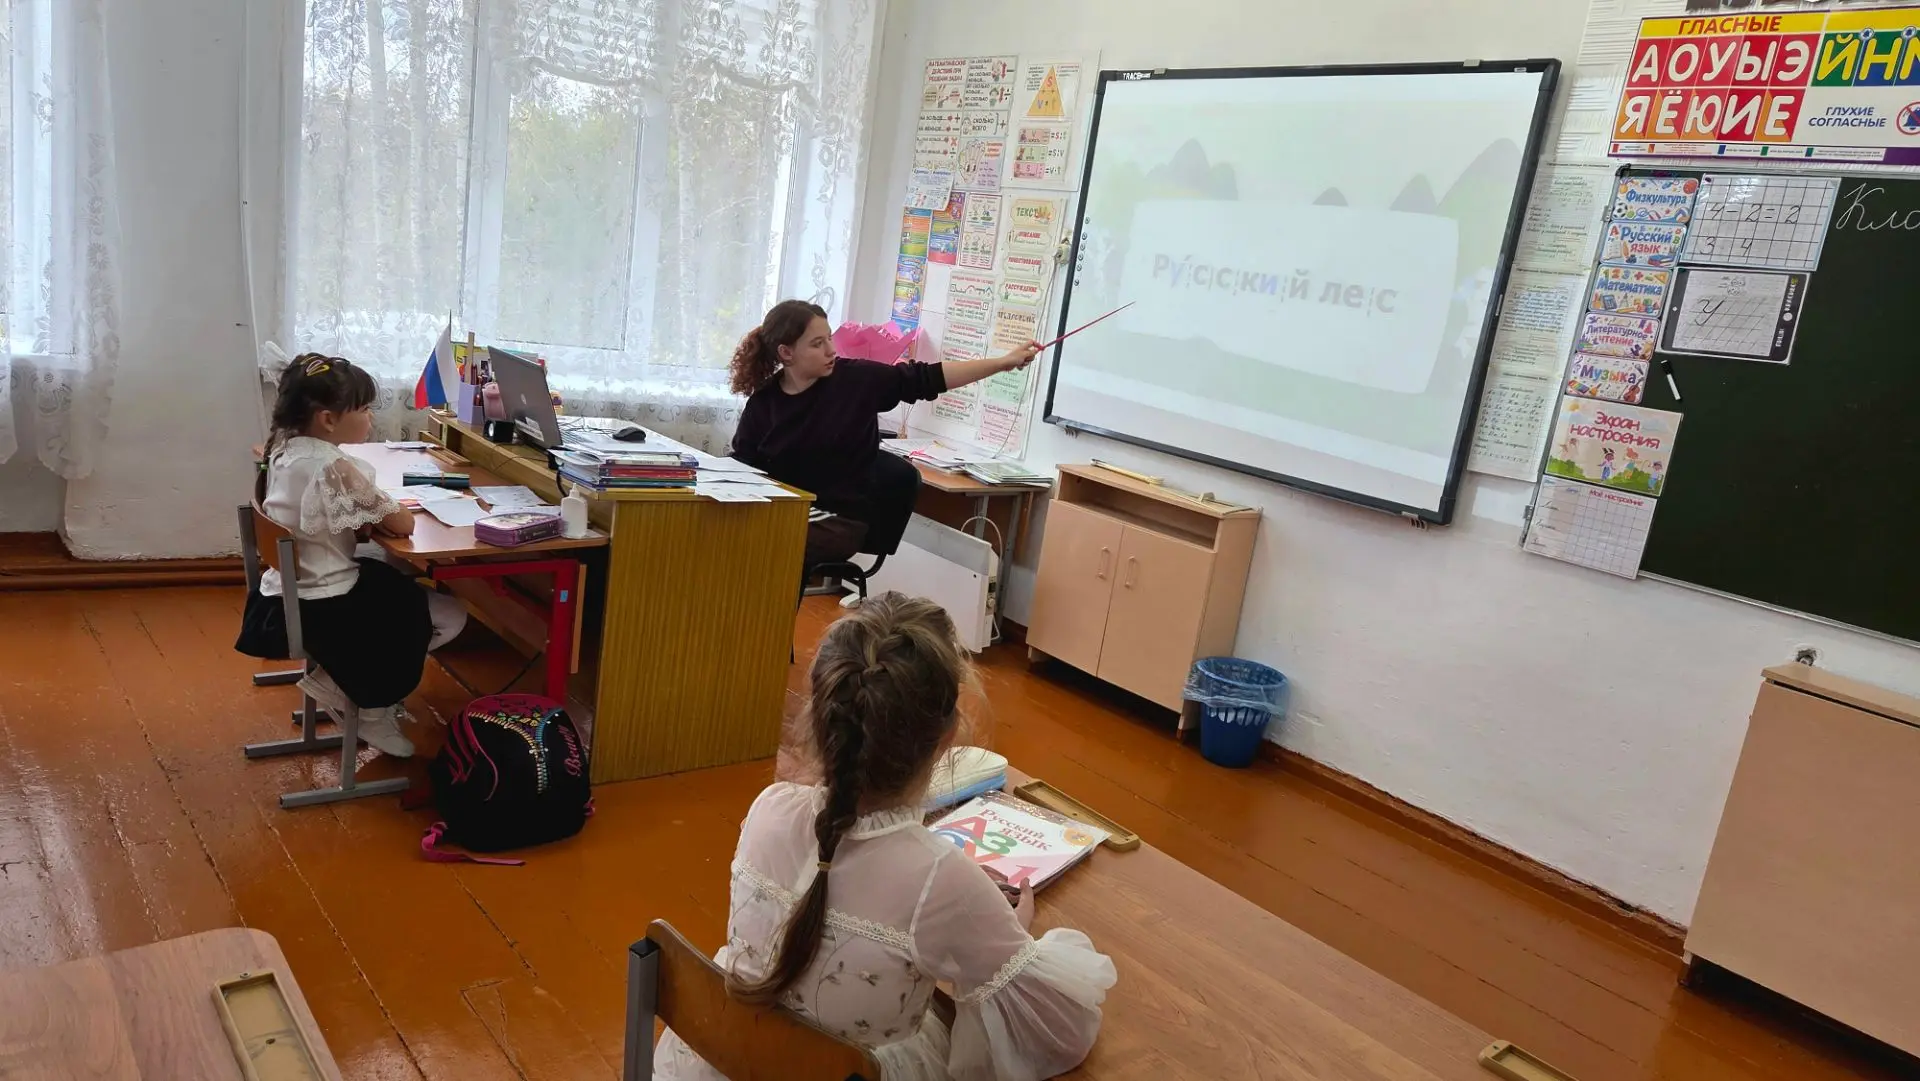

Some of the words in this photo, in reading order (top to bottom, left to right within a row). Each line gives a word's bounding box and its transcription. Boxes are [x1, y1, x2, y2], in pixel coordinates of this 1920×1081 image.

[1678, 16, 1782, 34] ГЛАСНЫЕ
[1825, 106, 1875, 116] ГЛУХИЕ
[1808, 117, 1887, 127] СОГЛАСНЫЕ
[1626, 189, 1687, 206] Физкультура
[1745, 203, 1762, 222] 2
[1784, 205, 1801, 224] 2
[1621, 225, 1672, 243] Русский
[1597, 277, 1662, 295] Математика
[1586, 325, 1648, 341] Литературное
[1599, 335, 1634, 347] чтение
[1580, 364, 1637, 384] Музыка
[1594, 411, 1640, 431] Экран
[1570, 424, 1660, 449] настроения
[979, 808, 1045, 839] Русский
